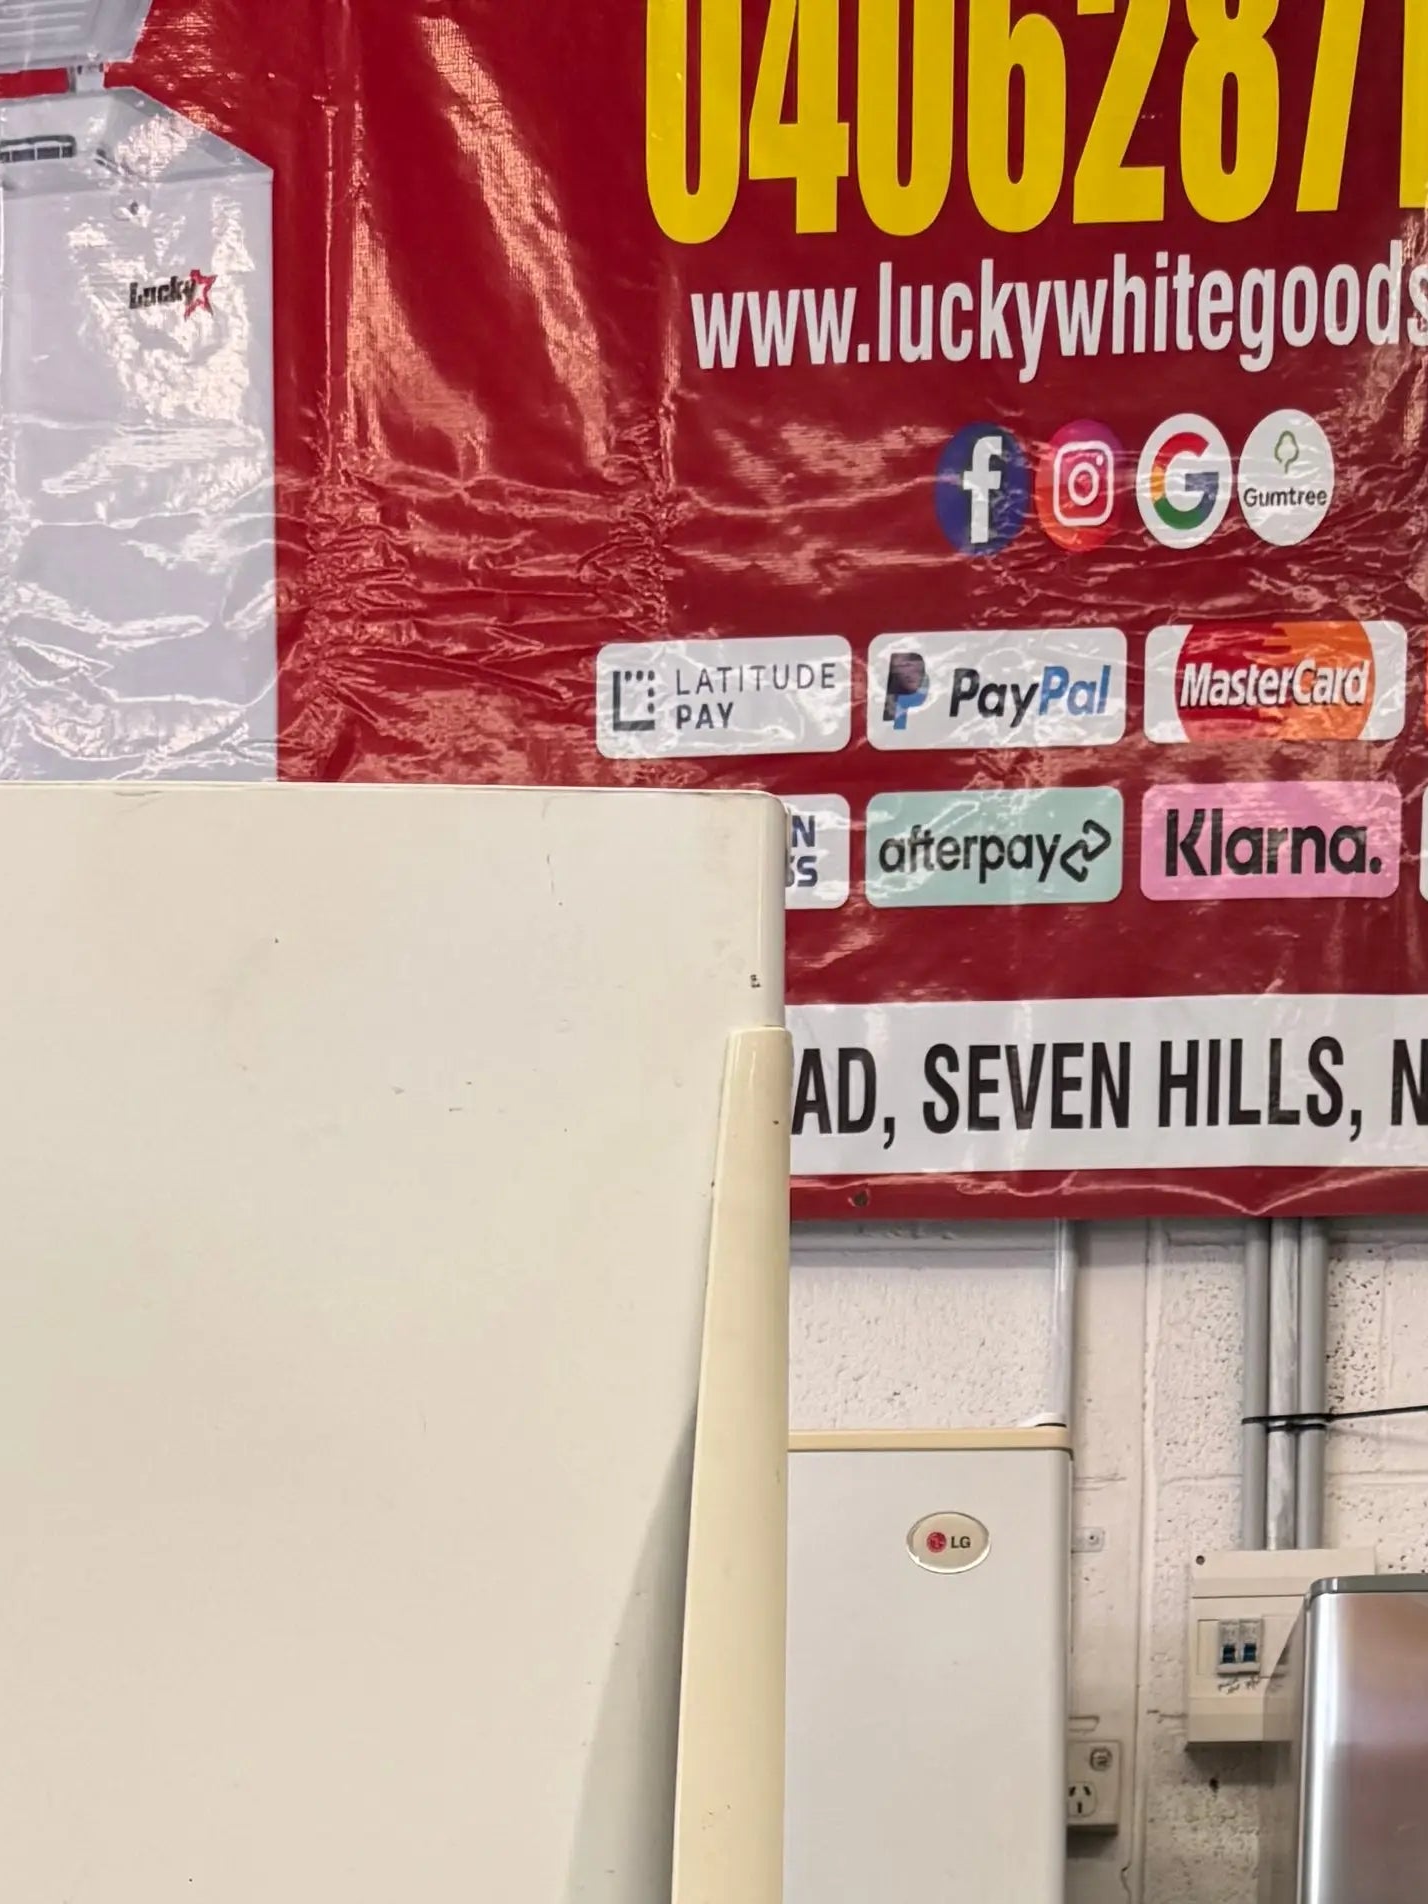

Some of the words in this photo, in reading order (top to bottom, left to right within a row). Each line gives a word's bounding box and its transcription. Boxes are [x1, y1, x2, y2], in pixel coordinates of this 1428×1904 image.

[128, 276, 197, 310] Lucky
[1242, 481, 1329, 512] Gumtree
[675, 661, 838, 697] LATITUDE
[948, 663, 1113, 721] PayPal
[1180, 654, 1371, 709] MasterCard
[675, 700, 735, 731] PAY
[878, 824, 1063, 880] afterpay
[1164, 807, 1382, 876] Klarna.
[922, 1039, 1132, 1136] SEVEN
[1159, 1034, 1363, 1142] HILLS,
[951, 1536, 971, 1548] LG
